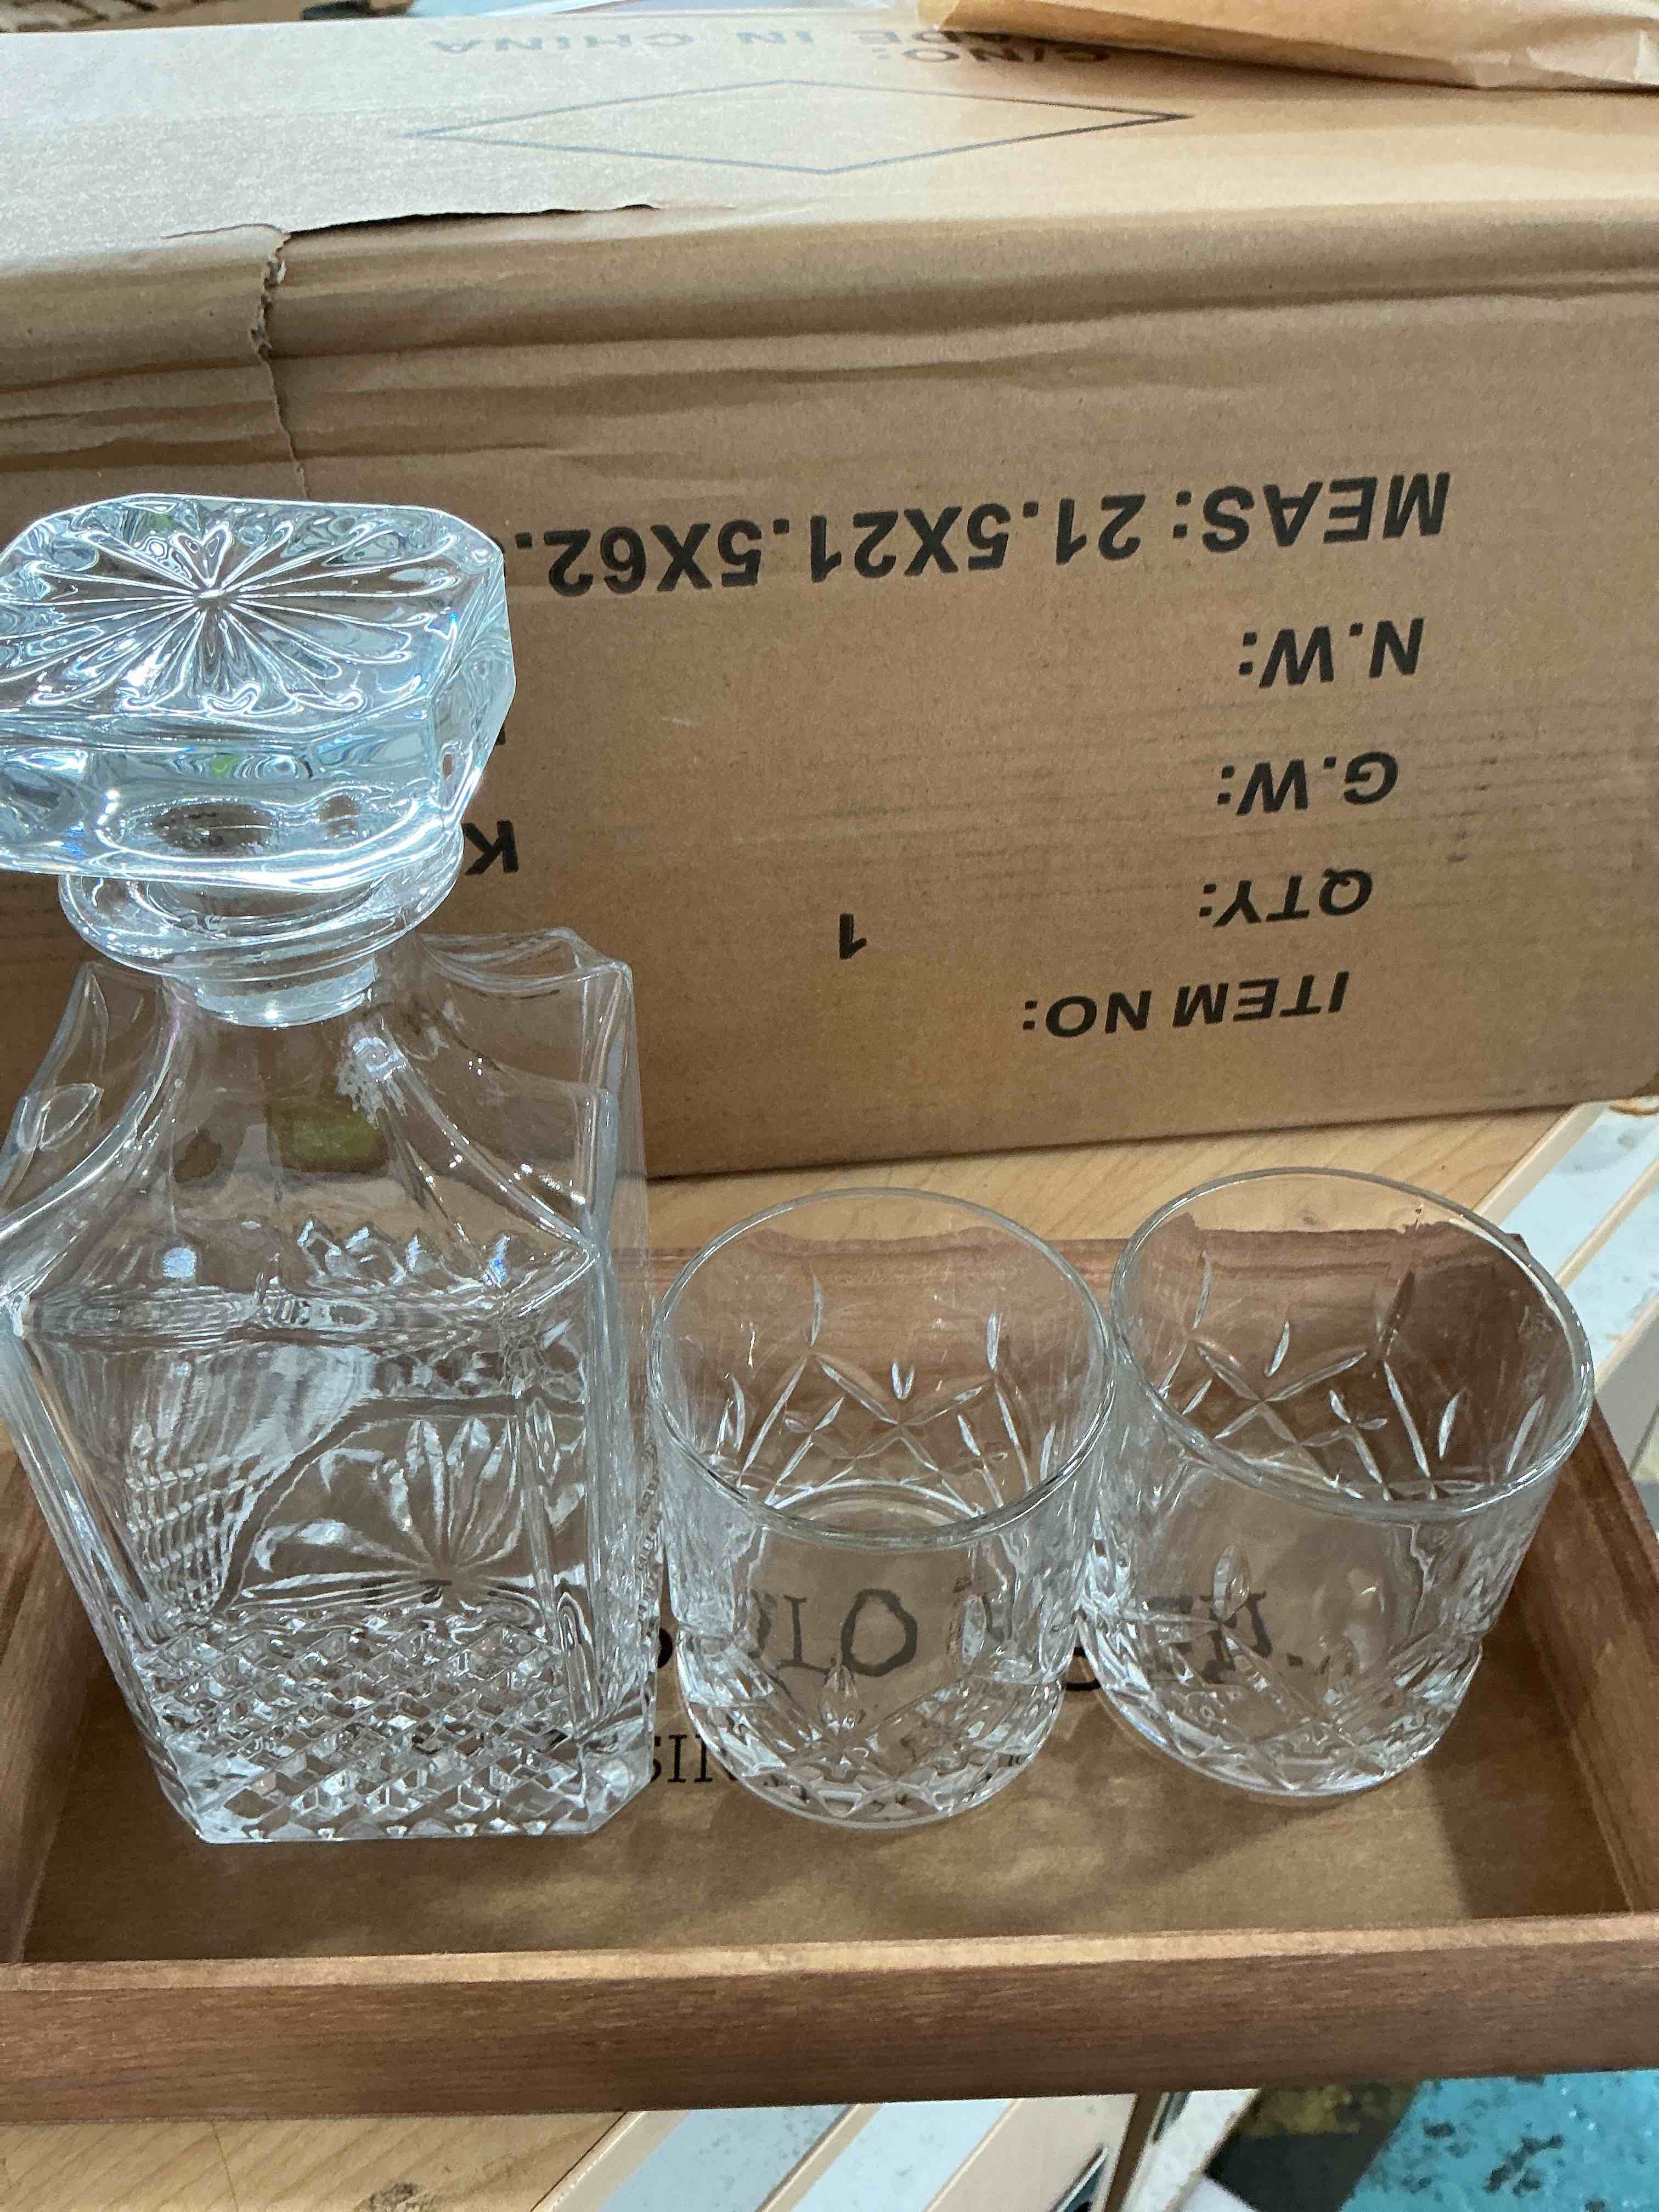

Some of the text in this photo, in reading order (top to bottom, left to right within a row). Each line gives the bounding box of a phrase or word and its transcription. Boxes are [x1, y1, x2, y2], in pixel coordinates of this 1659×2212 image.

[431, 33, 693, 53] CHINA
[736, 31, 814, 45] IN
[485, 472, 1450, 597] MEAS: 21.5X21.5X62.
[1239, 618, 1424, 689] N.W:
[1217, 752, 1398, 816] G.W:
[839, 868, 1373, 960] QTY: 1
[1023, 972, 1349, 1037] ITEM NO:
